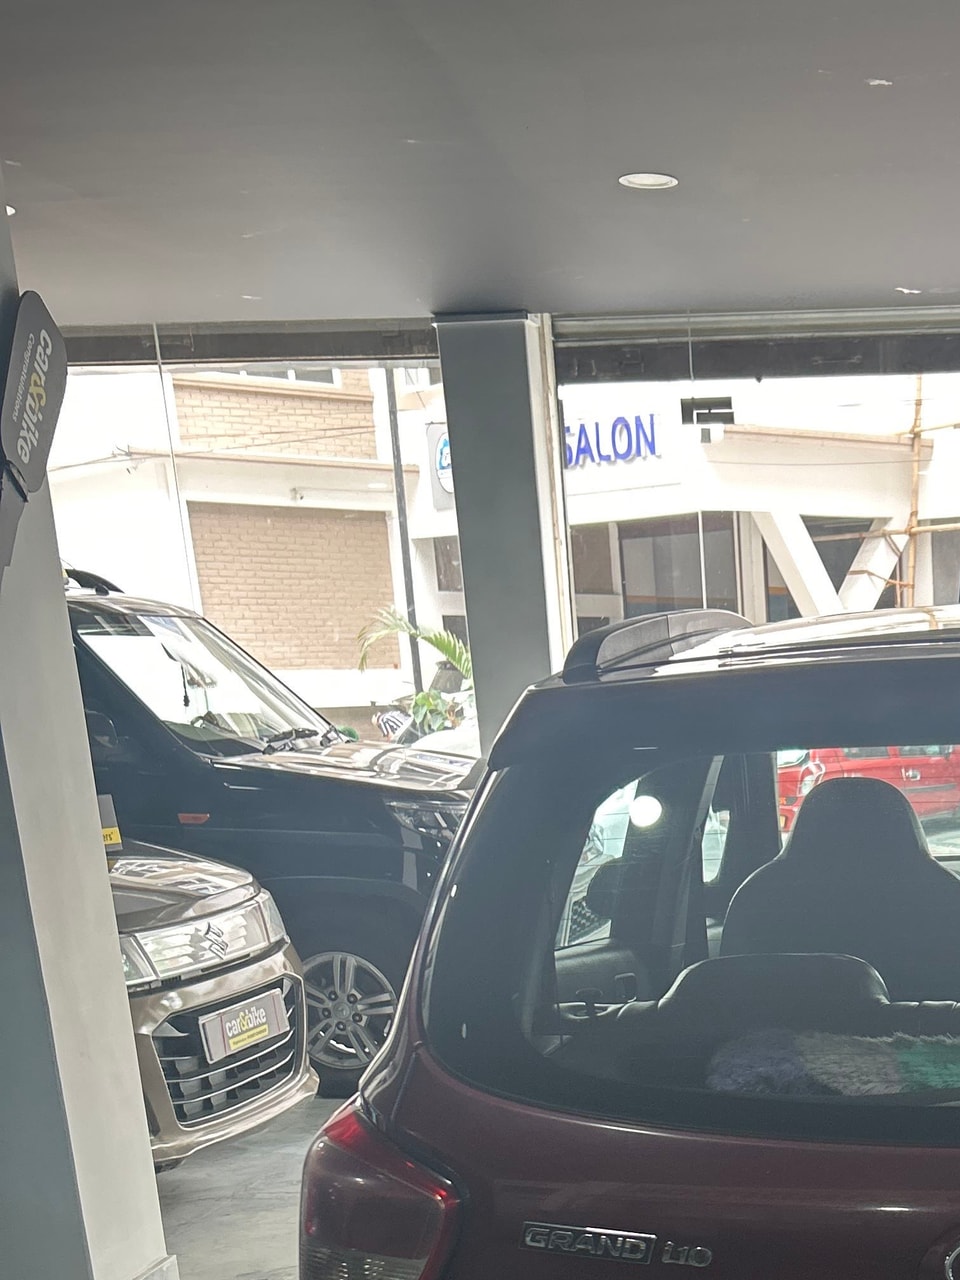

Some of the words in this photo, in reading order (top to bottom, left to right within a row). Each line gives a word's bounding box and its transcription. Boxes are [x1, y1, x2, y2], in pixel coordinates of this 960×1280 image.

[12, 333, 35, 424] Congratulations
[17, 328, 53, 465] car&bike
[225, 1006, 267, 1038] car&bike
[524, 1226, 647, 1259] GRAND
